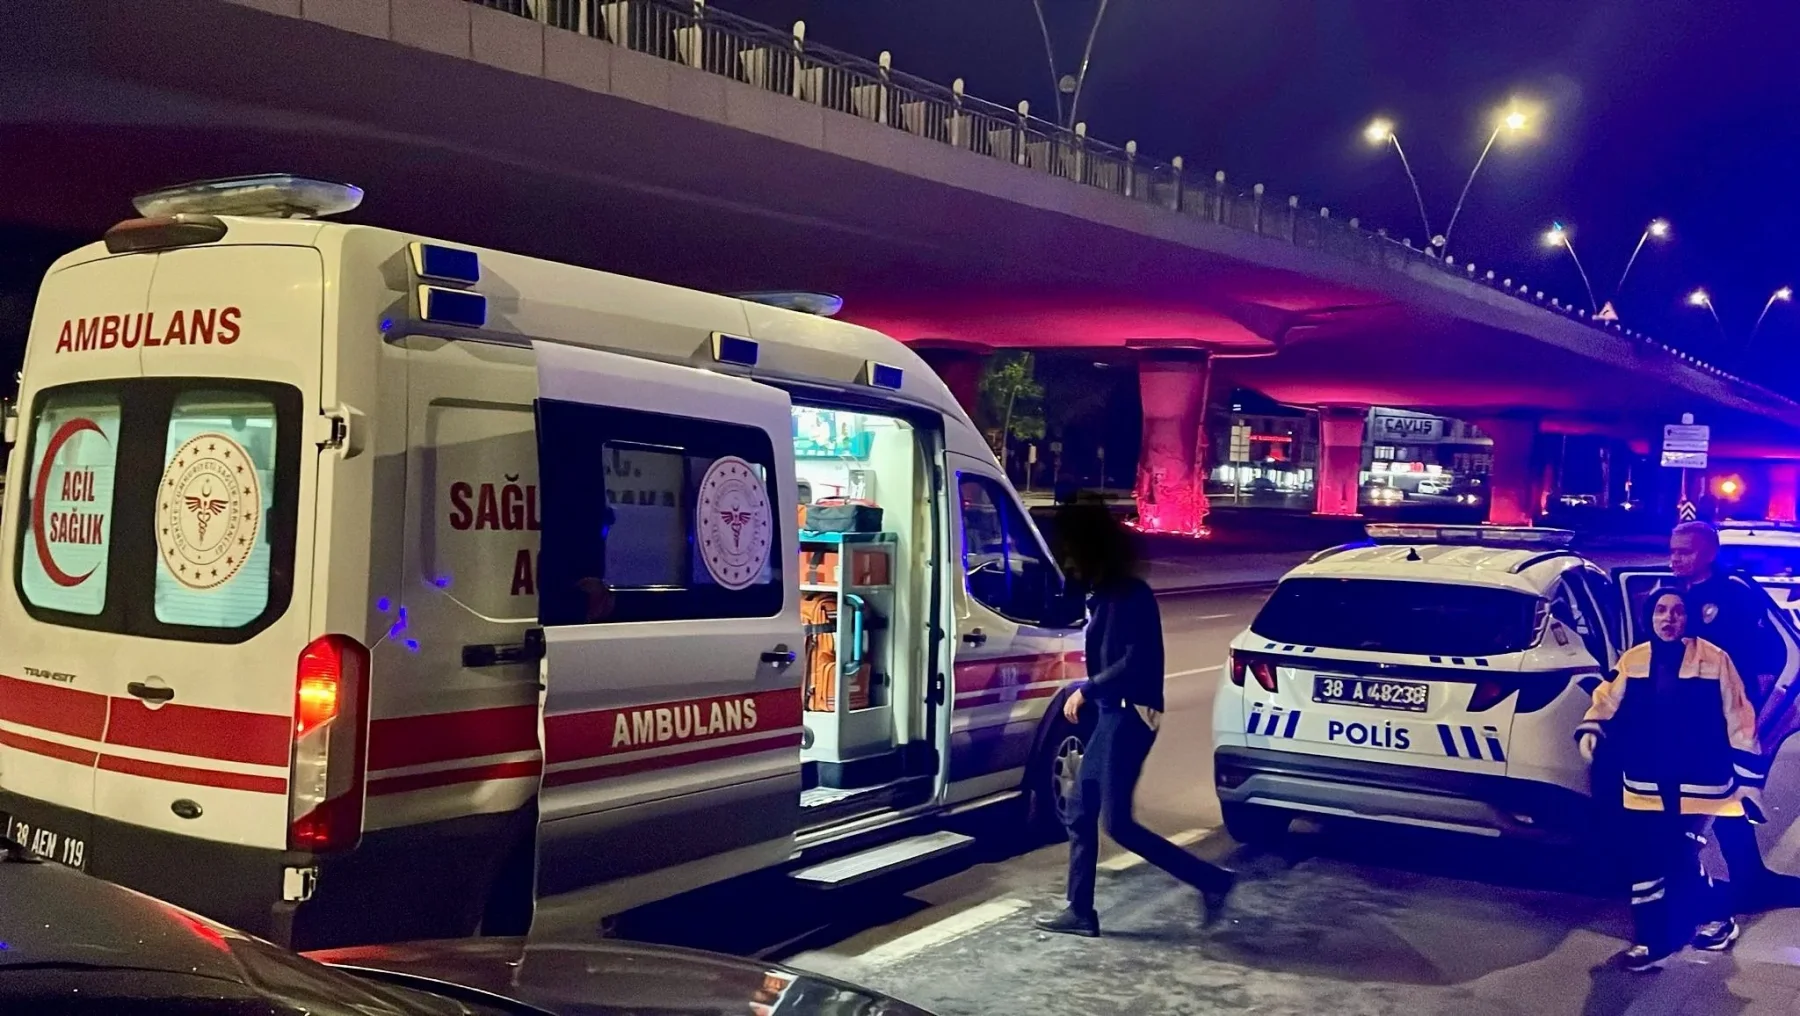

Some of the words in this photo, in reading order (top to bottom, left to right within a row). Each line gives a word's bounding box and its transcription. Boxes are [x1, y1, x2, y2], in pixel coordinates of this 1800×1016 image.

[56, 306, 242, 354] AMBULANS
[61, 466, 95, 502] ACİL
[50, 507, 104, 545] SAĞLIK
[511, 549, 540, 596] A
[1322, 679, 1344, 697] 38
[1352, 681, 1364, 700] A
[611, 698, 758, 748] AMBULANS
[1328, 720, 1411, 750] POLİS
[31, 828, 58, 859] AEN
[62, 837, 84, 867] 119
